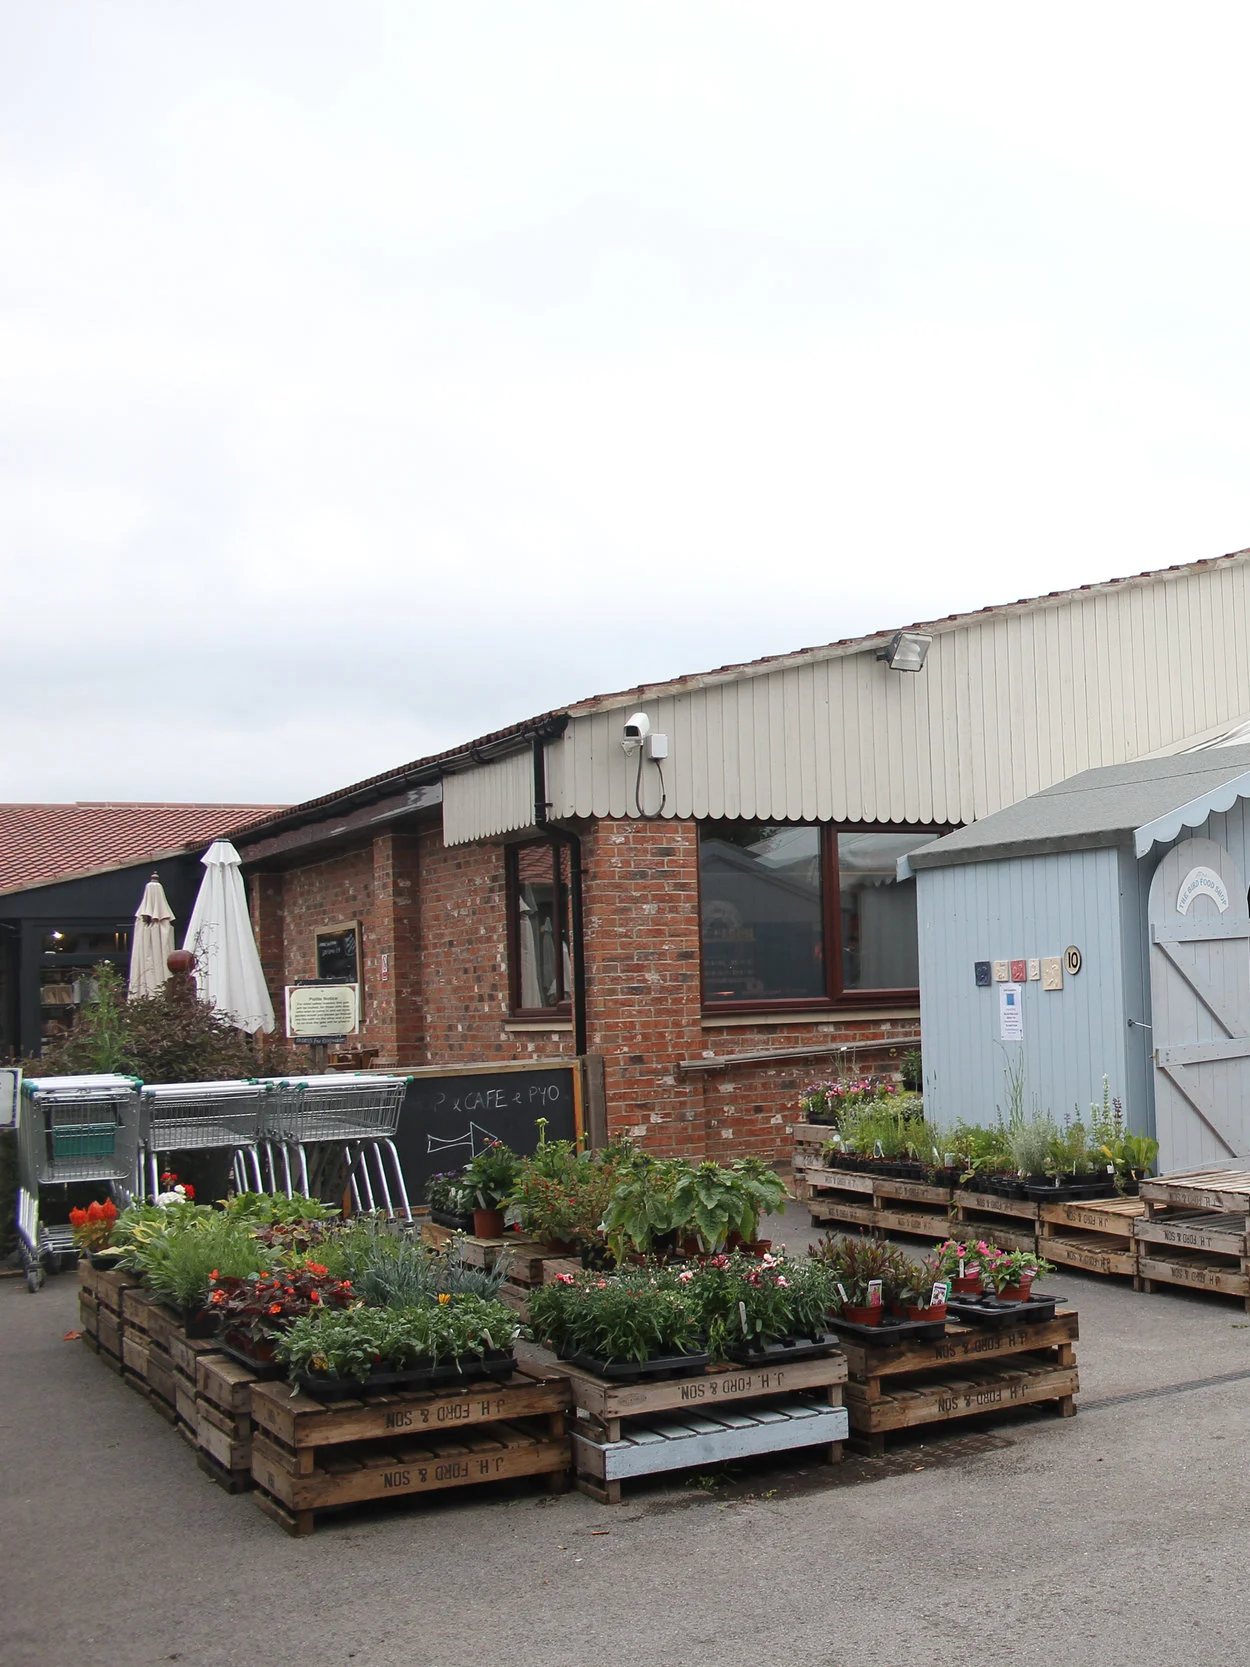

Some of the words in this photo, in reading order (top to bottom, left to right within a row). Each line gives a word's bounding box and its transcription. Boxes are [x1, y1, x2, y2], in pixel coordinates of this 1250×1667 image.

[1200, 878, 1215, 889] FOOD
[1215, 886, 1227, 905] SHOP
[1067, 951, 1078, 968] 10
[464, 1089, 508, 1110] CAFE
[529, 1085, 560, 1106] PYO
[677, 1384, 705, 1401] SON.
[709, 1381, 718, 1395] &
[722, 1376, 752, 1394] FORD
[963, 1394, 971, 1408] &
[976, 1388, 1002, 1406] FORD
[420, 1408, 429, 1423] &
[437, 1403, 470, 1421] FORD
[418, 1468, 428, 1483] &
[435, 1462, 469, 1481] FORD
